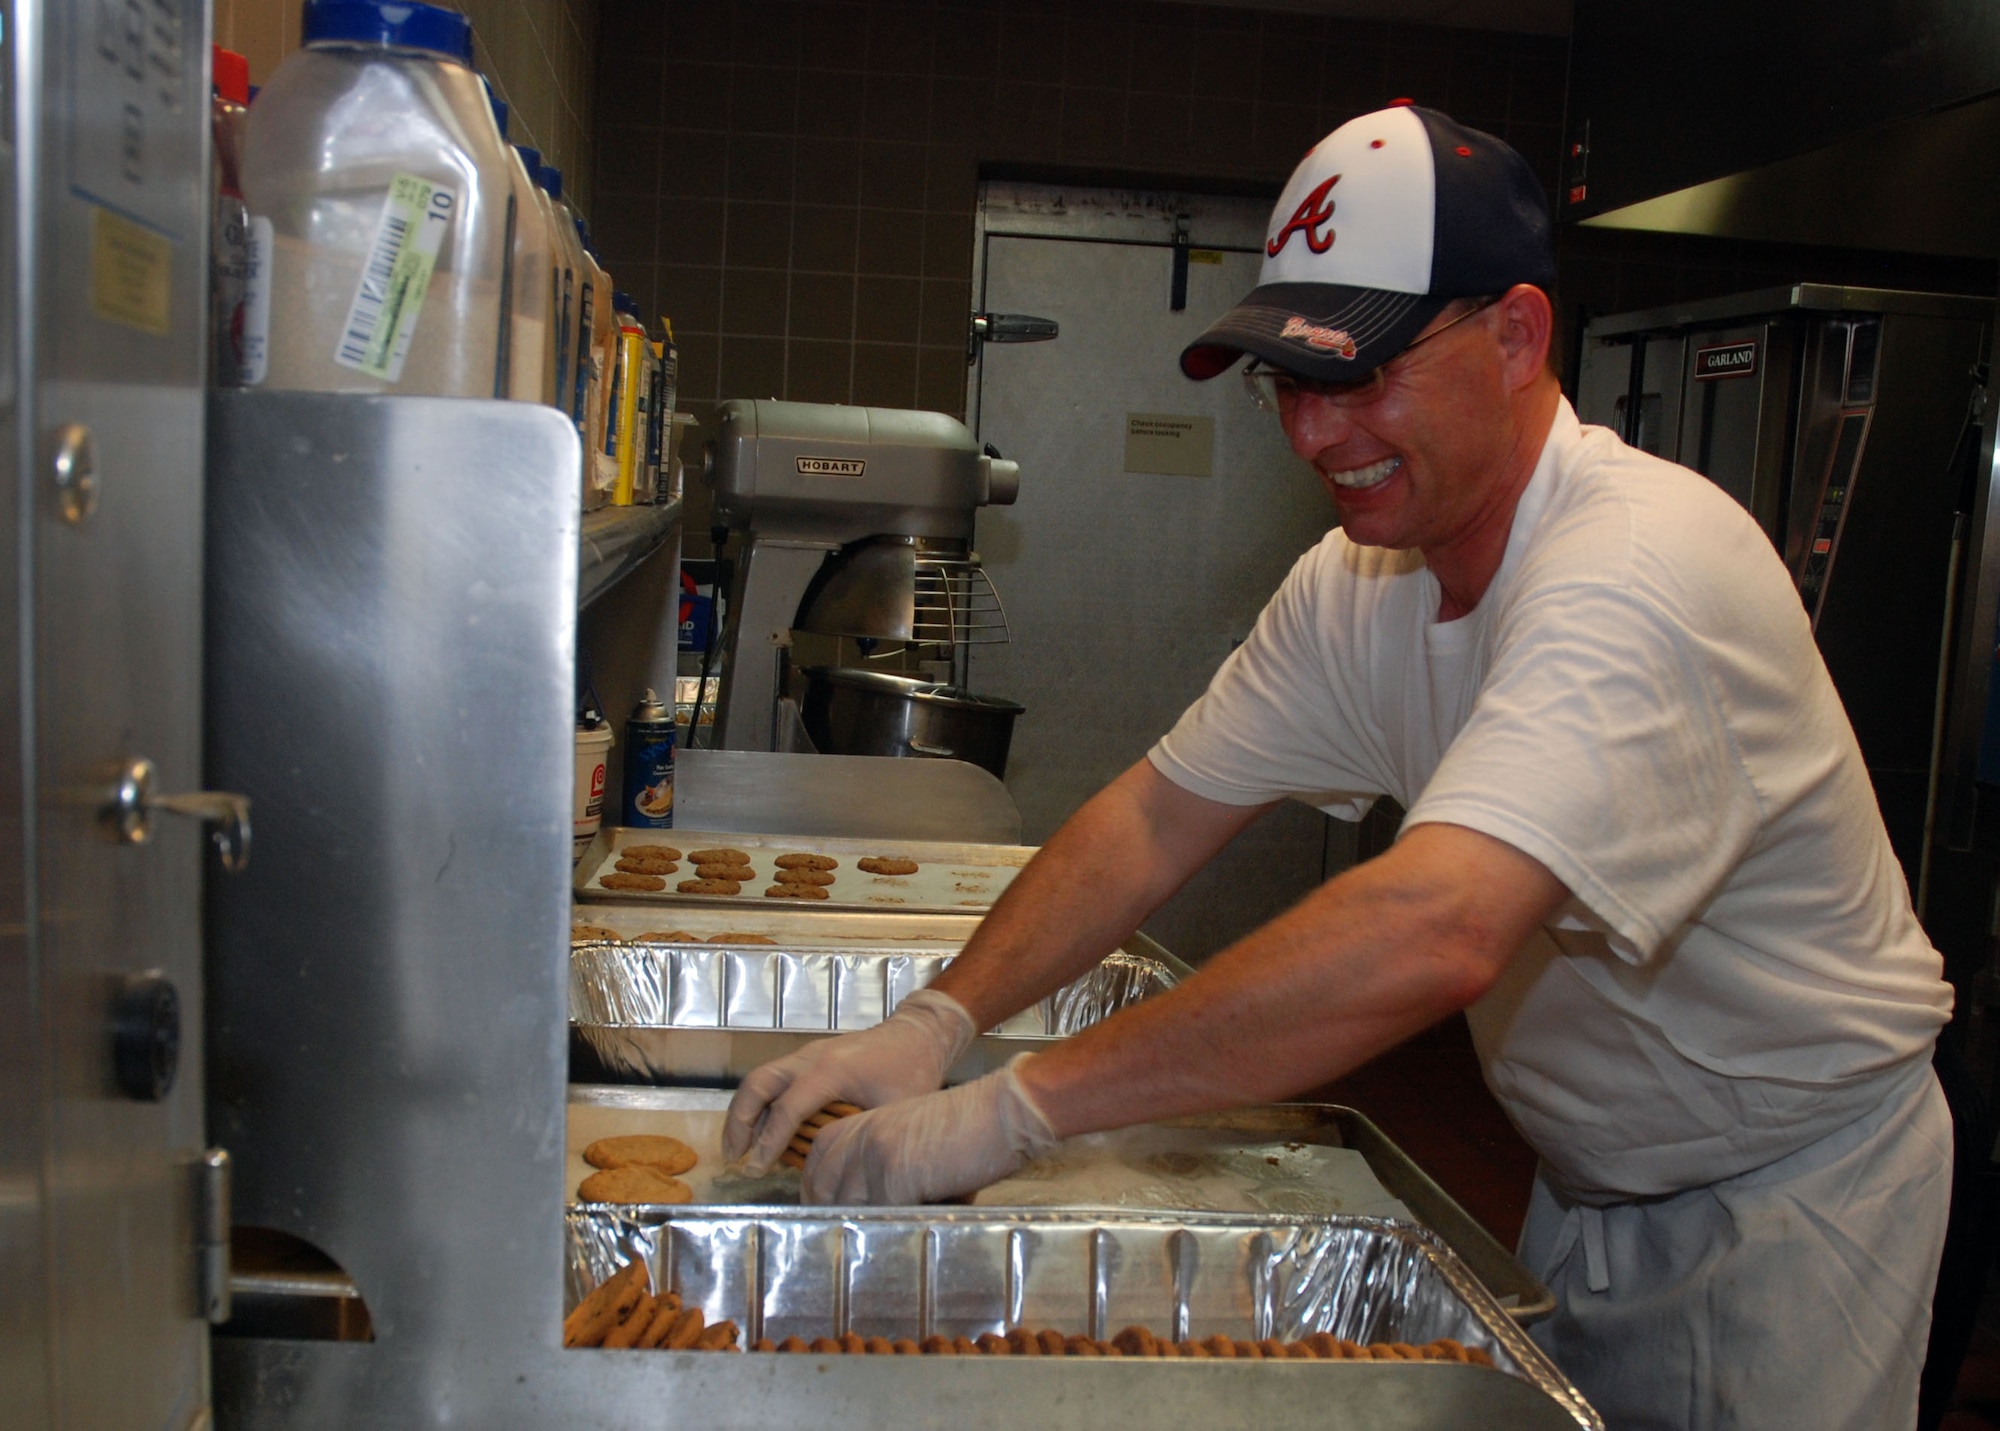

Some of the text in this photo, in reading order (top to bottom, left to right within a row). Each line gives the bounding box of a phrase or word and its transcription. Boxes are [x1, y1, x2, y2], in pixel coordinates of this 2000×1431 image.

[428, 192, 452, 222] 10
[1267, 174, 1341, 258] A
[1708, 351, 1752, 367] GARLAND
[802, 461, 859, 471] HOBART
